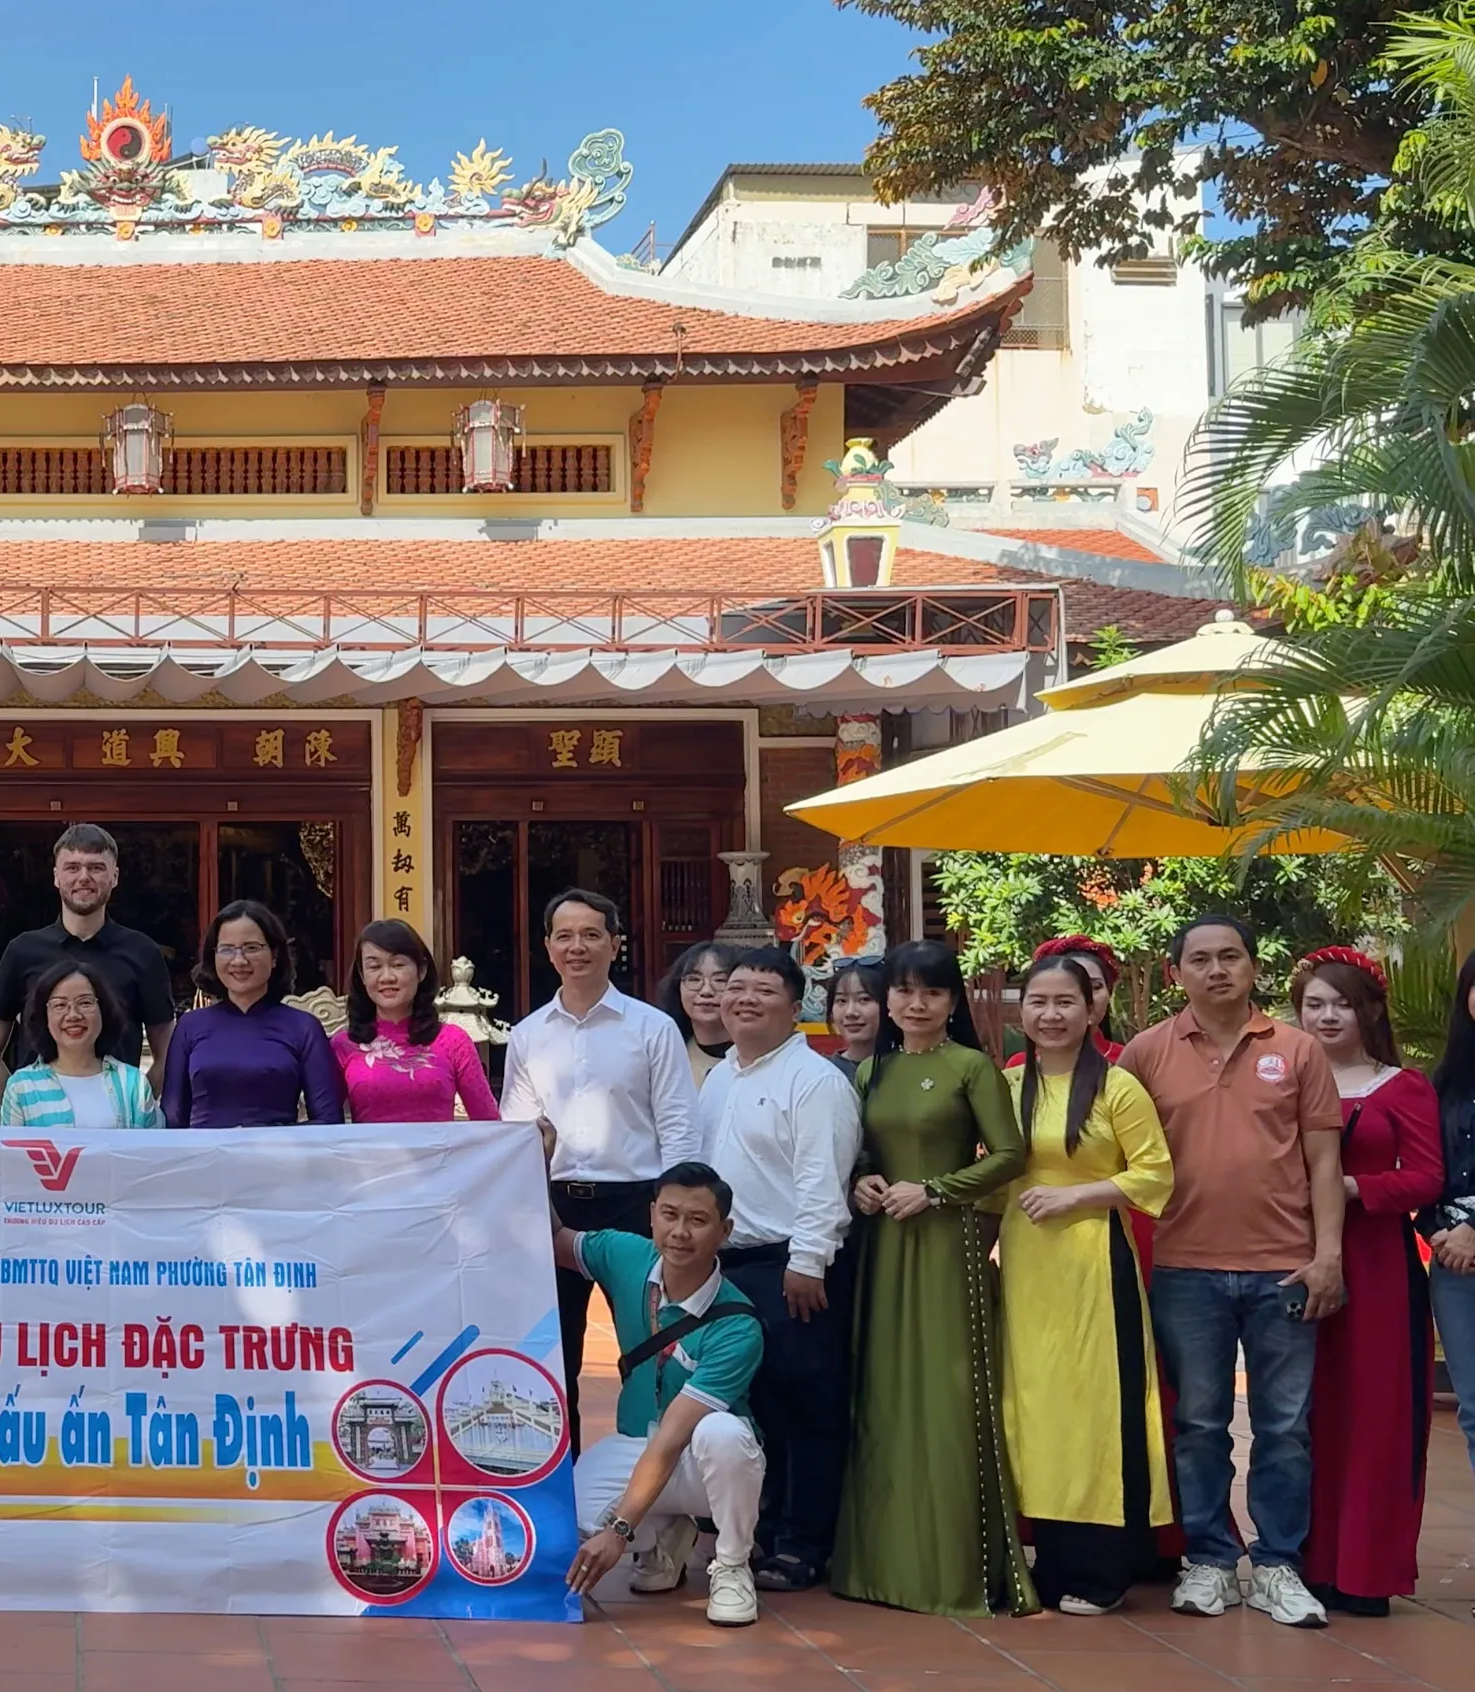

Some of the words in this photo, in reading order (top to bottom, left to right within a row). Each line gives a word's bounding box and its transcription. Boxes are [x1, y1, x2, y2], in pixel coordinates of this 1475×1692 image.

[3, 1201, 106, 1215] VIETLUXTOUR
[66, 1254, 103, 1290] VIỆT
[109, 1259, 150, 1286] NAM
[156, 1256, 227, 1288] PHƯỜNG
[233, 1255, 268, 1288] TÂN
[273, 1261, 318, 1294] ĐỊNH
[17, 1322, 108, 1377] LỊCH
[121, 1315, 205, 1379] ĐẶC
[218, 1321, 355, 1373] TRƯNG
[60, 1384, 113, 1467] ấn
[125, 1391, 201, 1468] Tân
[213, 1390, 312, 1489] Định
